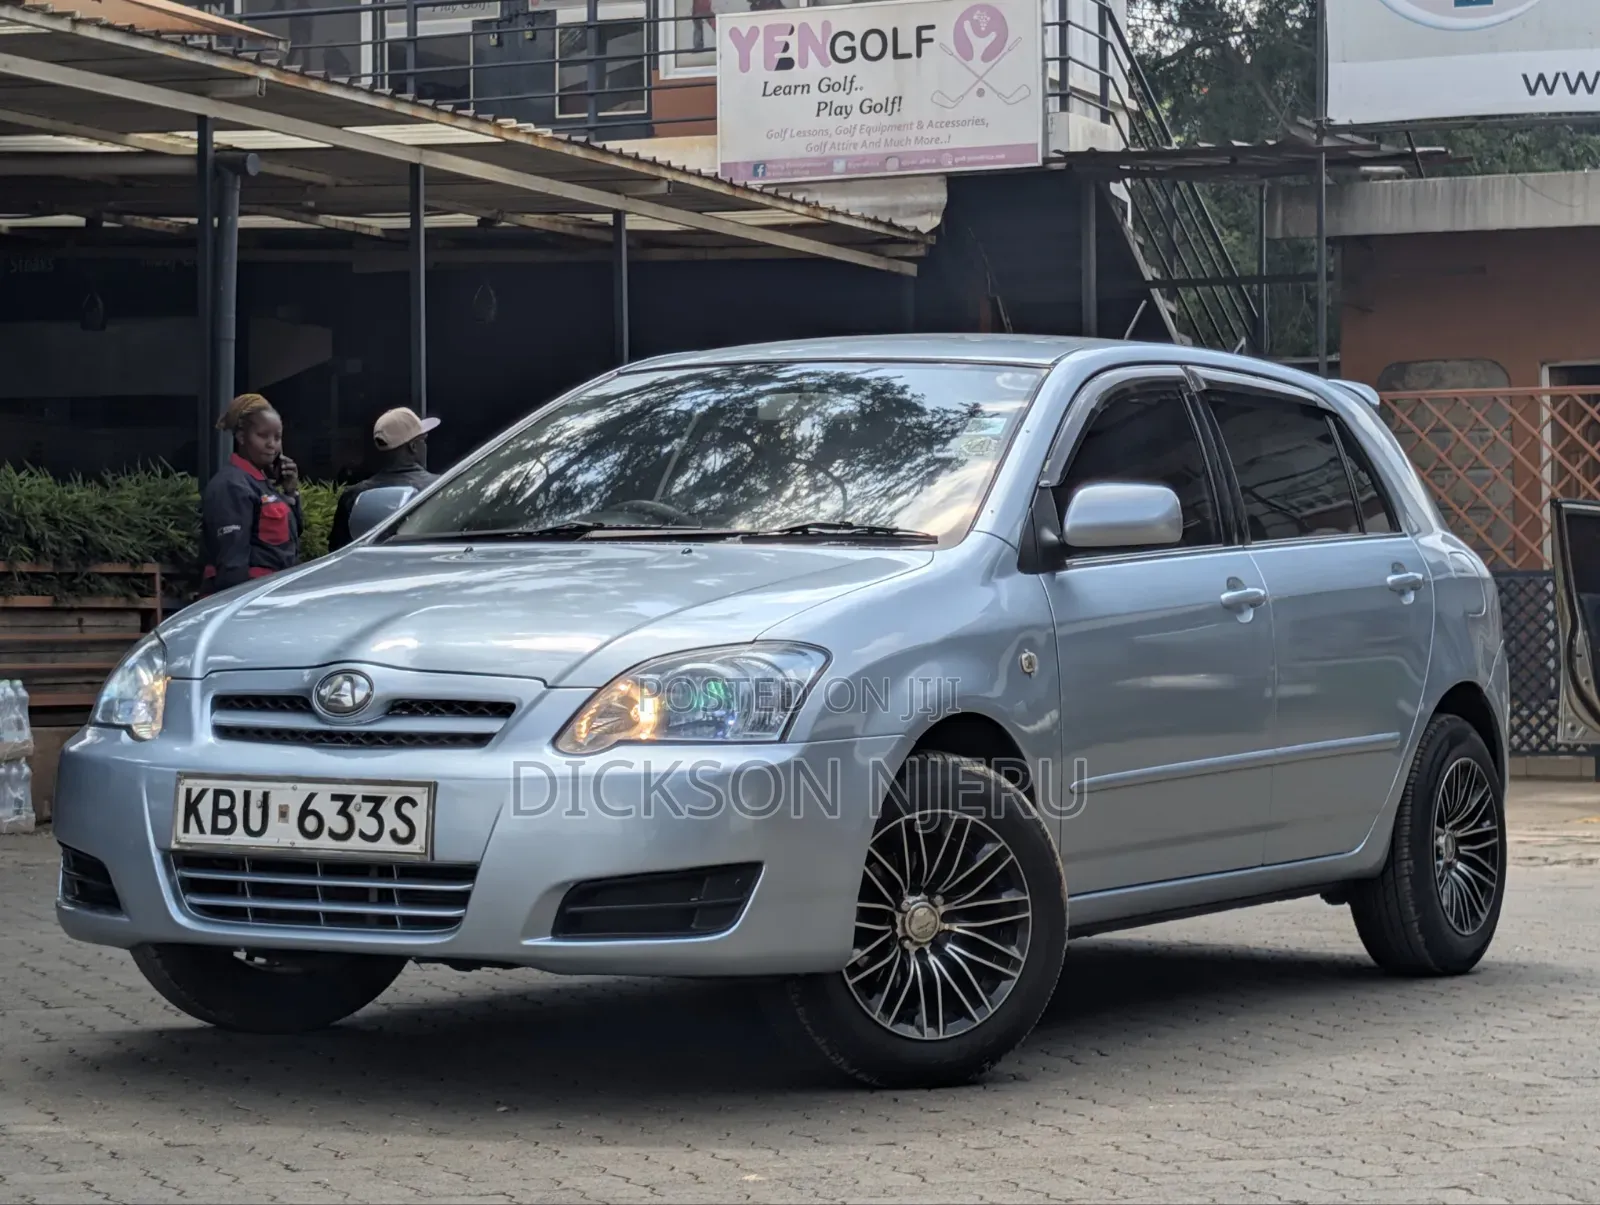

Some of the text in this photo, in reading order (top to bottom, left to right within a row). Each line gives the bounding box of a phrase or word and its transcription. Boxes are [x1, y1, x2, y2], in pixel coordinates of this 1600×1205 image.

[762, 80, 811, 98] Learn
[816, 96, 903, 119] Play Golf!
[766, 128, 789, 142] Golf
[789, 126, 832, 139] Lessons,
[835, 123, 858, 137] Golf
[859, 120, 913, 136] Equipment
[916, 119, 924, 130] &
[805, 141, 829, 154] Golf
[829, 139, 858, 151] Attire
[861, 138, 880, 150] And
[884, 136, 911, 148] Much
[183, 787, 420, 846] KBU 633S
